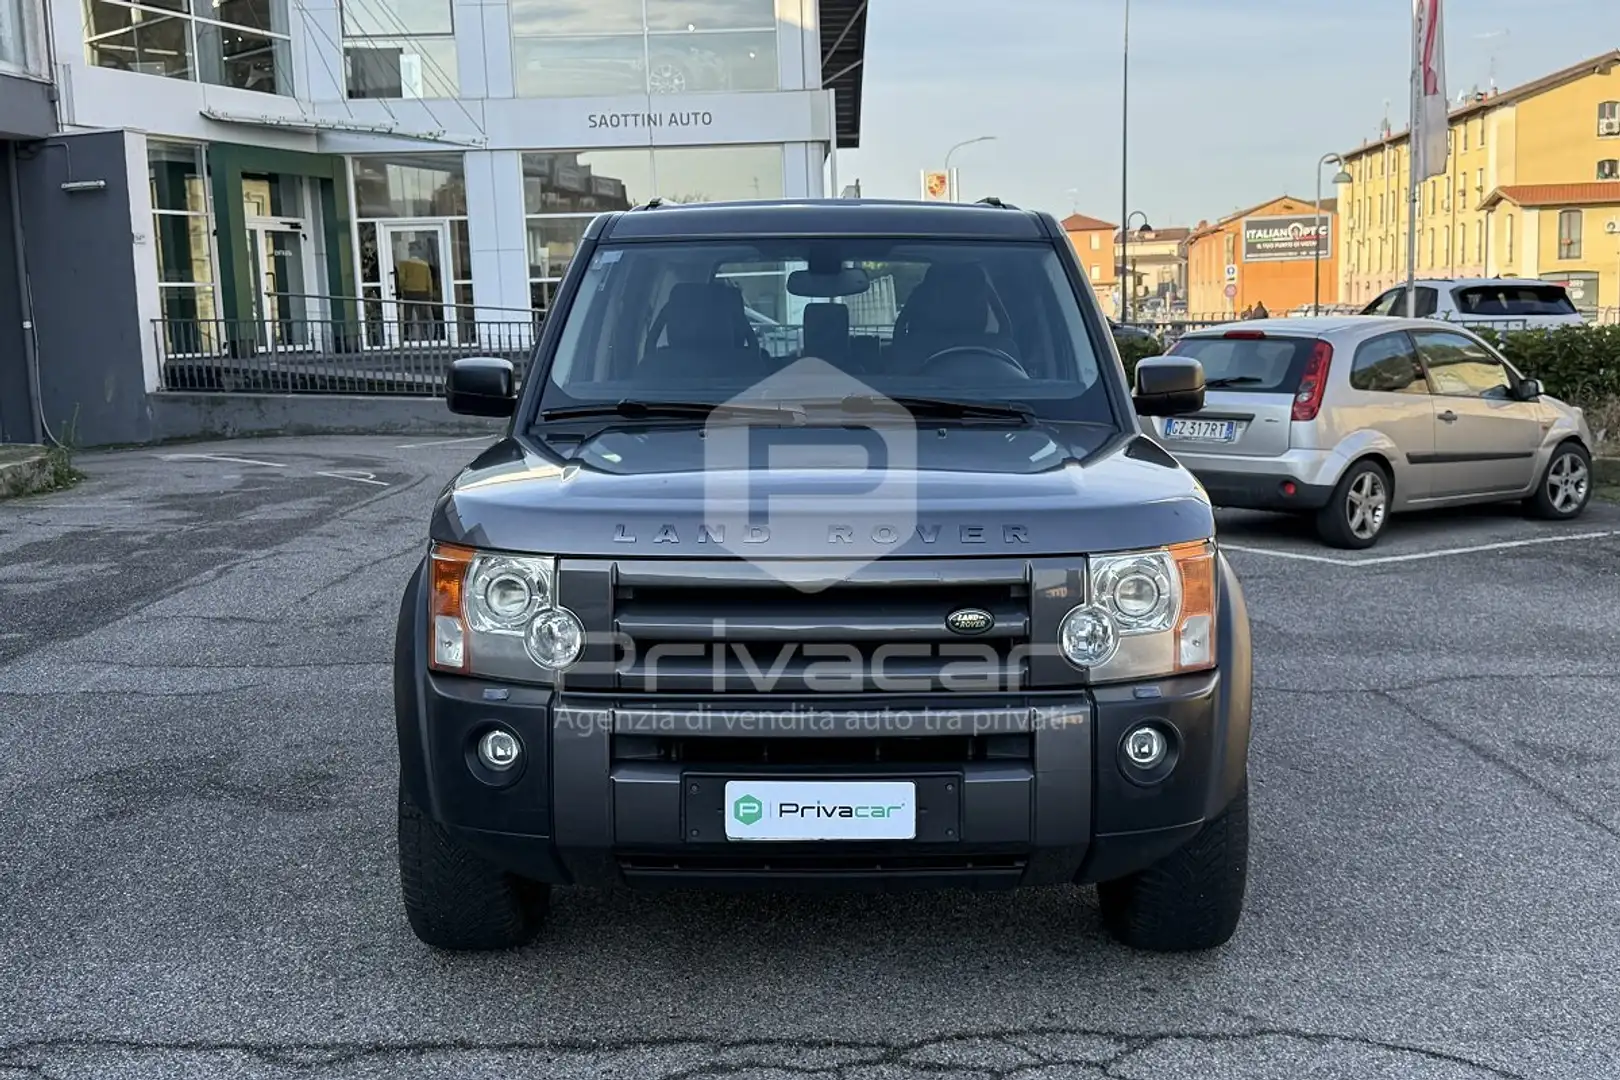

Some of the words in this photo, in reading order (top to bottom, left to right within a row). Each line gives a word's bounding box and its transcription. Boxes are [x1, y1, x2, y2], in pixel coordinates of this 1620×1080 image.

[588, 112, 664, 129] SAOTTINI
[668, 111, 713, 127] AUTO
[1246, 222, 1328, 240] ITALIANOPTC
[1188, 421, 1226, 437] 317RT
[613, 523, 771, 544] LAND
[827, 523, 1031, 544] ROVER
[957, 613, 980, 621] LAND
[960, 620, 986, 628] ROVER
[778, 801, 902, 818] Privacar
